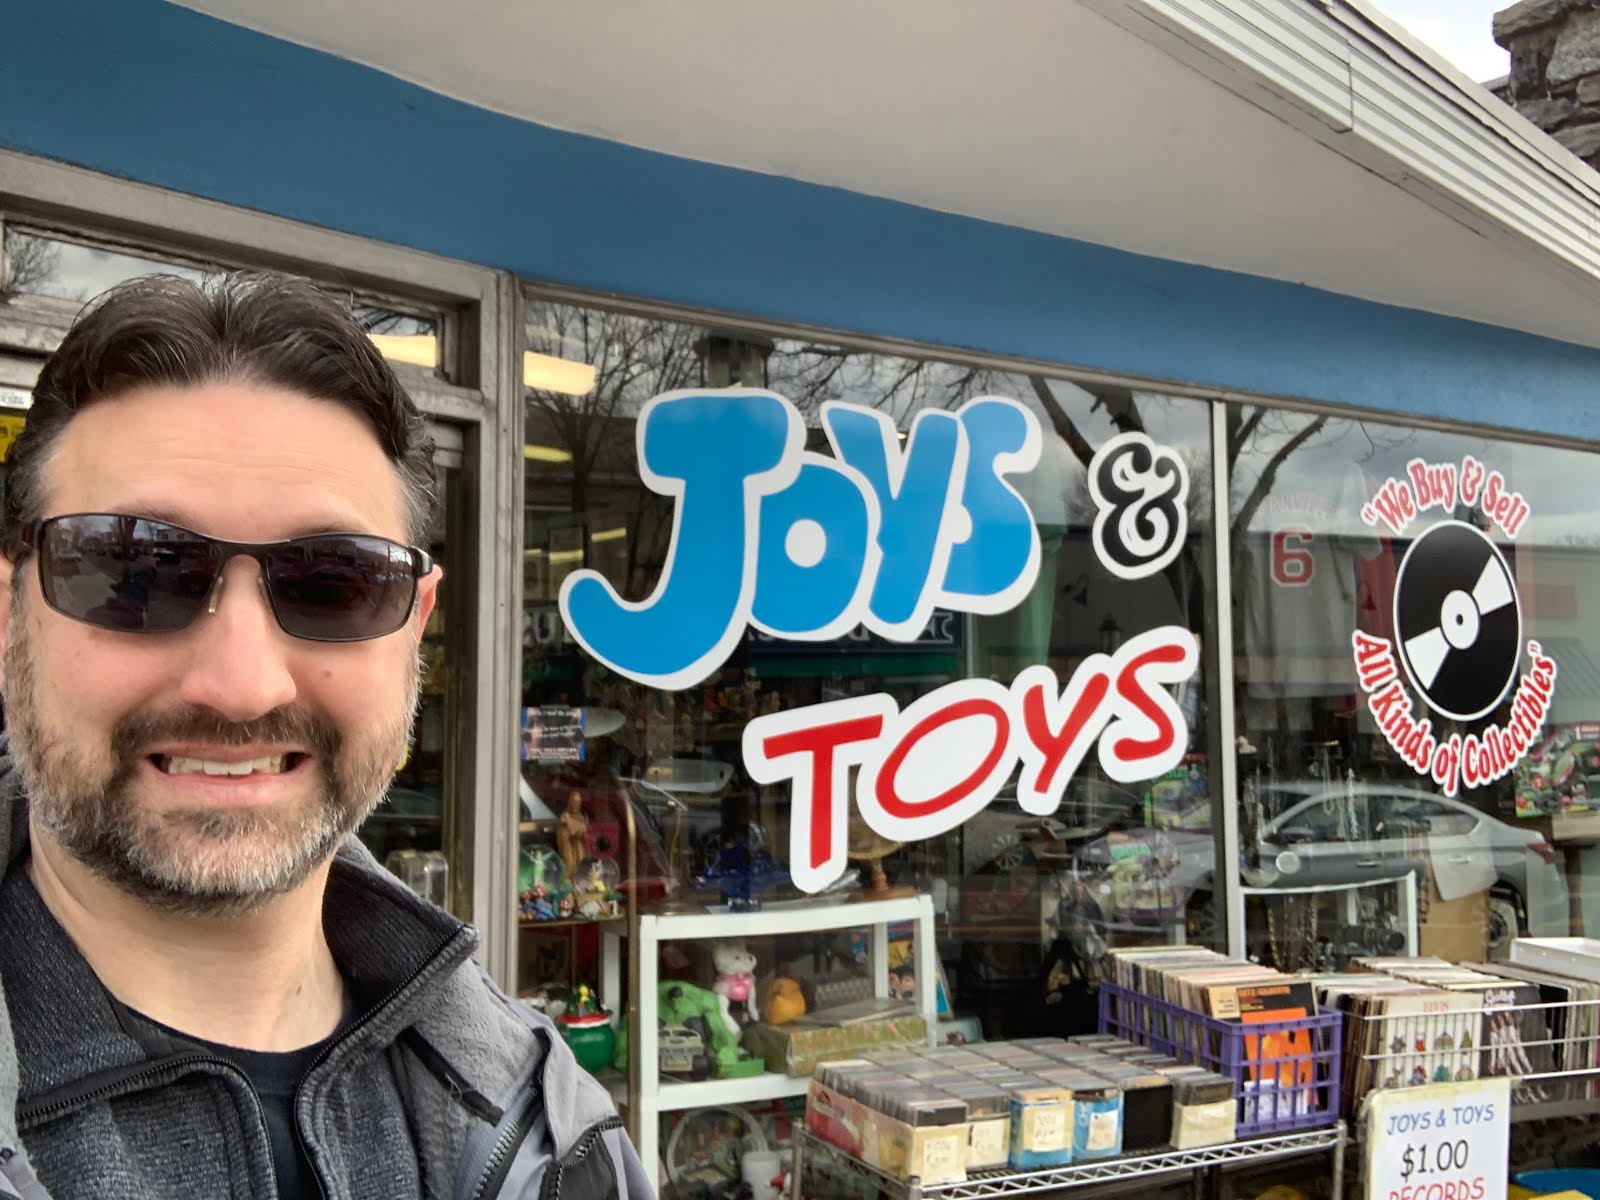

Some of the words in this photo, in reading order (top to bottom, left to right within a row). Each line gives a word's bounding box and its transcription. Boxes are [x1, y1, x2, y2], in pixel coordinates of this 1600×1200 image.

[1407, 457, 1457, 513] Buy
[1459, 455, 1485, 506] &
[1481, 471, 1530, 539] Sell
[561, 389, 1040, 688] JOYS
[1089, 433, 1188, 577] &
[1271, 525, 1313, 586] 6
[1353, 630, 1398, 692] All
[1369, 680, 1436, 774] Kinds
[743, 628, 1198, 891] TOYS
[1431, 733, 1461, 797] of
[1387, 1111, 1431, 1135] JOYS
[1435, 1109, 1446, 1128] &
[1453, 1103, 1495, 1125] TOYS
[1400, 1139, 1469, 1183] $1.00
